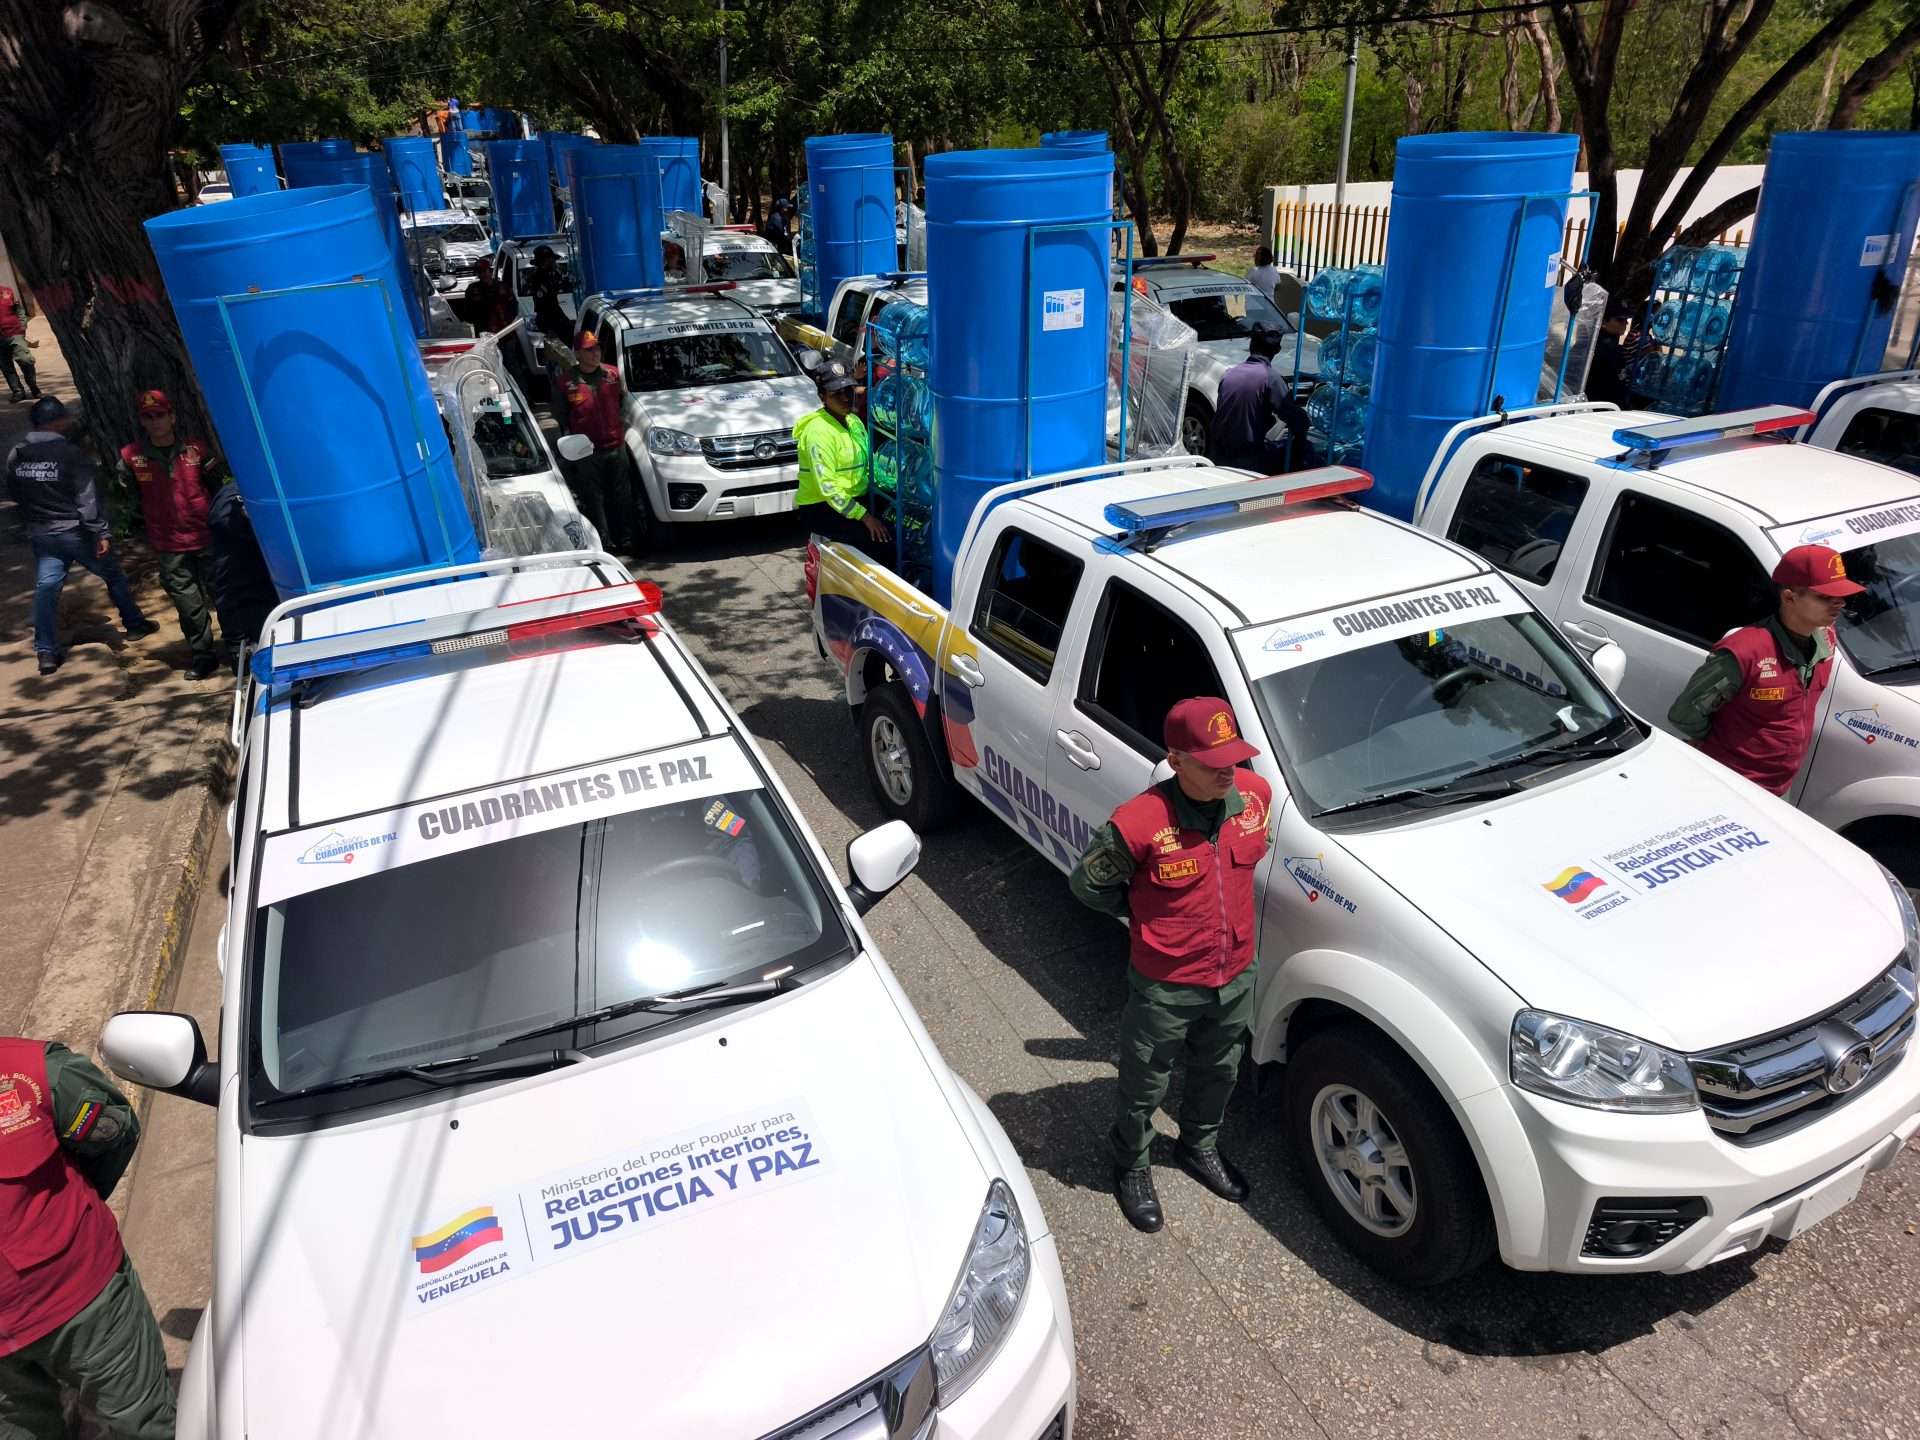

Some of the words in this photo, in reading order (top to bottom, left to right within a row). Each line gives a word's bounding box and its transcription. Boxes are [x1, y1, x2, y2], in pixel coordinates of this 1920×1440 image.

[667, 322, 727, 334] CUADRANTES
[727, 321, 738, 329] DE
[740, 321, 755, 329] PAZ
[1333, 595, 1449, 637] CUADRANTES
[1444, 590, 1471, 610] DE
[1468, 586, 1501, 606] PAZ
[1847, 718, 1895, 740] CUADRANTES
[1893, 733, 1905, 743] DE
[1903, 736, 1920, 748] PAZ
[418, 772, 616, 841] CUADRANTES
[618, 765, 658, 795] DE
[658, 755, 713, 787] PAZ
[984, 745, 1097, 853] CUADRAN
[315, 839, 370, 861] CUADRANTES
[370, 836, 383, 846] DE
[383, 831, 398, 843] PAZ
[1604, 842, 1645, 863] Ministerio
[1657, 828, 1681, 842] Poder
[1679, 818, 1710, 837] Popular
[1709, 813, 1728, 827] para
[1614, 838, 1689, 873] Relaciones
[1684, 821, 1749, 847] Interiores,
[1633, 849, 1724, 889] JUSTICIA
[1710, 841, 1728, 857] Y
[1725, 831, 1770, 853] PAZ
[1294, 866, 1336, 899] CUADRANTES
[1334, 893, 1345, 906] DE
[1343, 899, 1358, 914] PAZ
[1581, 895, 1631, 920] VENEZUELA
[540, 1165, 619, 1200] Ministerio
[623, 1152, 648, 1175] del
[651, 1141, 696, 1164] Poder
[699, 1120, 758, 1154] Popular
[761, 1110, 796, 1135] para
[544, 1160, 684, 1219] Relaciones
[687, 1123, 810, 1172] Interiores,
[551, 1174, 714, 1251] JUSTICIA
[715, 1163, 740, 1191] Y
[747, 1142, 820, 1183] PAZ
[418, 1261, 511, 1304] VENEZUELA
